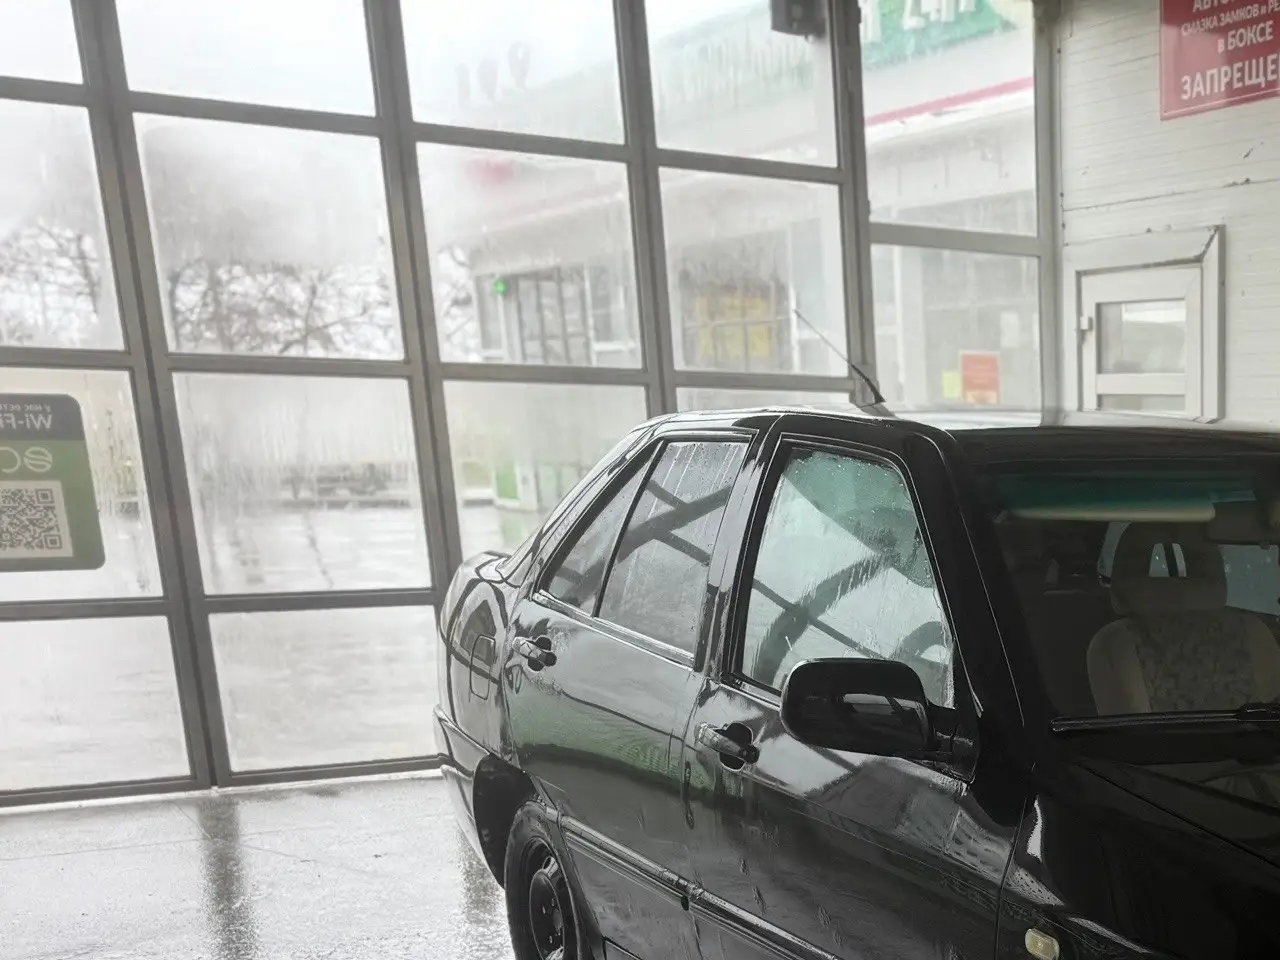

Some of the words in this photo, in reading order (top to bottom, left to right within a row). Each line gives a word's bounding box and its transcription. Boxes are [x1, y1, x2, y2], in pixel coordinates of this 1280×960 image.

[1181, 15, 1218, 36] СМАЗКА
[1220, 4, 1259, 26] ЗАМКОВ
[1228, 20, 1274, 49] БОКСЕ
